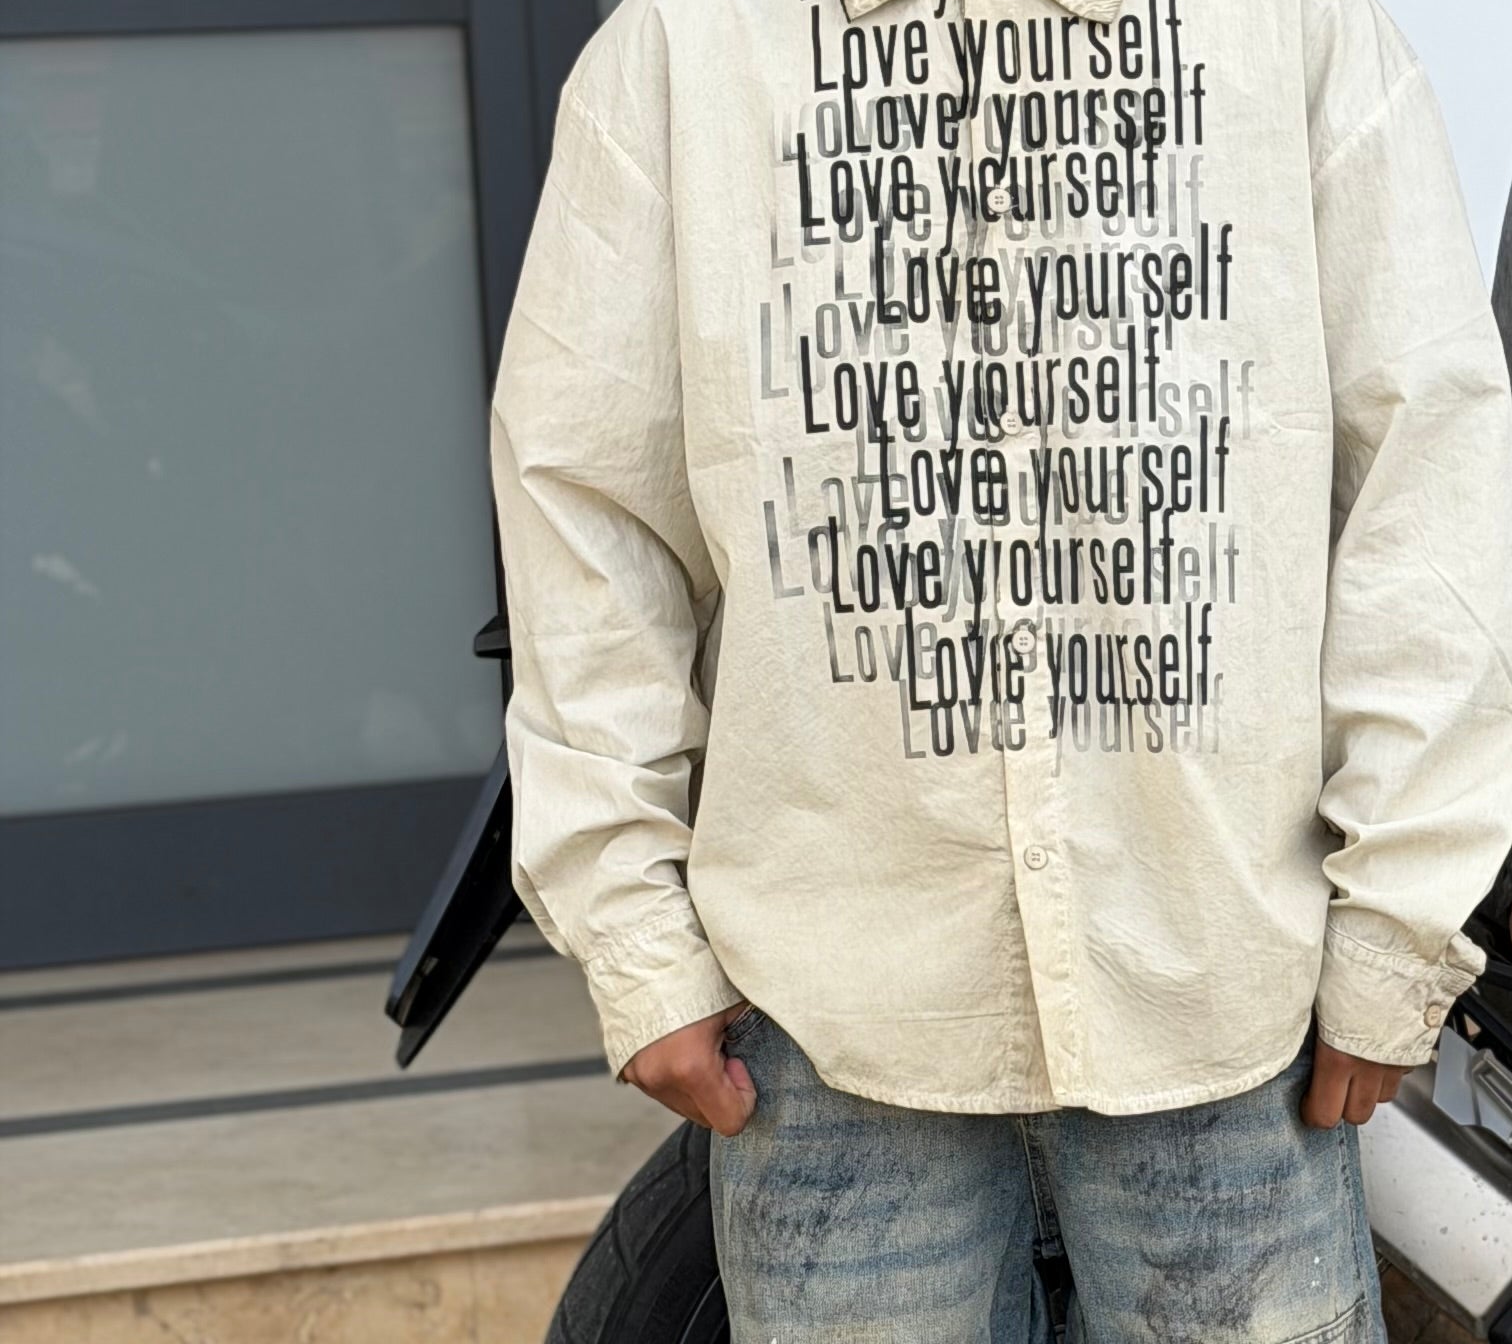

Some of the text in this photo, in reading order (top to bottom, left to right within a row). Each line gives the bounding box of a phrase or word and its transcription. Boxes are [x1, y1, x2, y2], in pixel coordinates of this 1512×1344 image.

[811, 5, 929, 93] Love
[797, 133, 915, 228] Love
[937, 120, 1159, 257] yourself
[843, 73, 959, 154] Love
[991, 61, 1206, 184] yourself
[874, 226, 1001, 325] Love
[1024, 222, 1233, 358] yourself
[800, 335, 920, 434] Love
[942, 325, 1160, 459] yourself
[880, 420, 1009, 518] Love
[1030, 414, 1230, 549] yourself
[828, 516, 943, 613] Love
[963, 506, 1174, 640] yourself
[899, 672, 1224, 778] Love yourself
[905, 607, 1025, 711] Love
[1046, 602, 1212, 739] yourself
